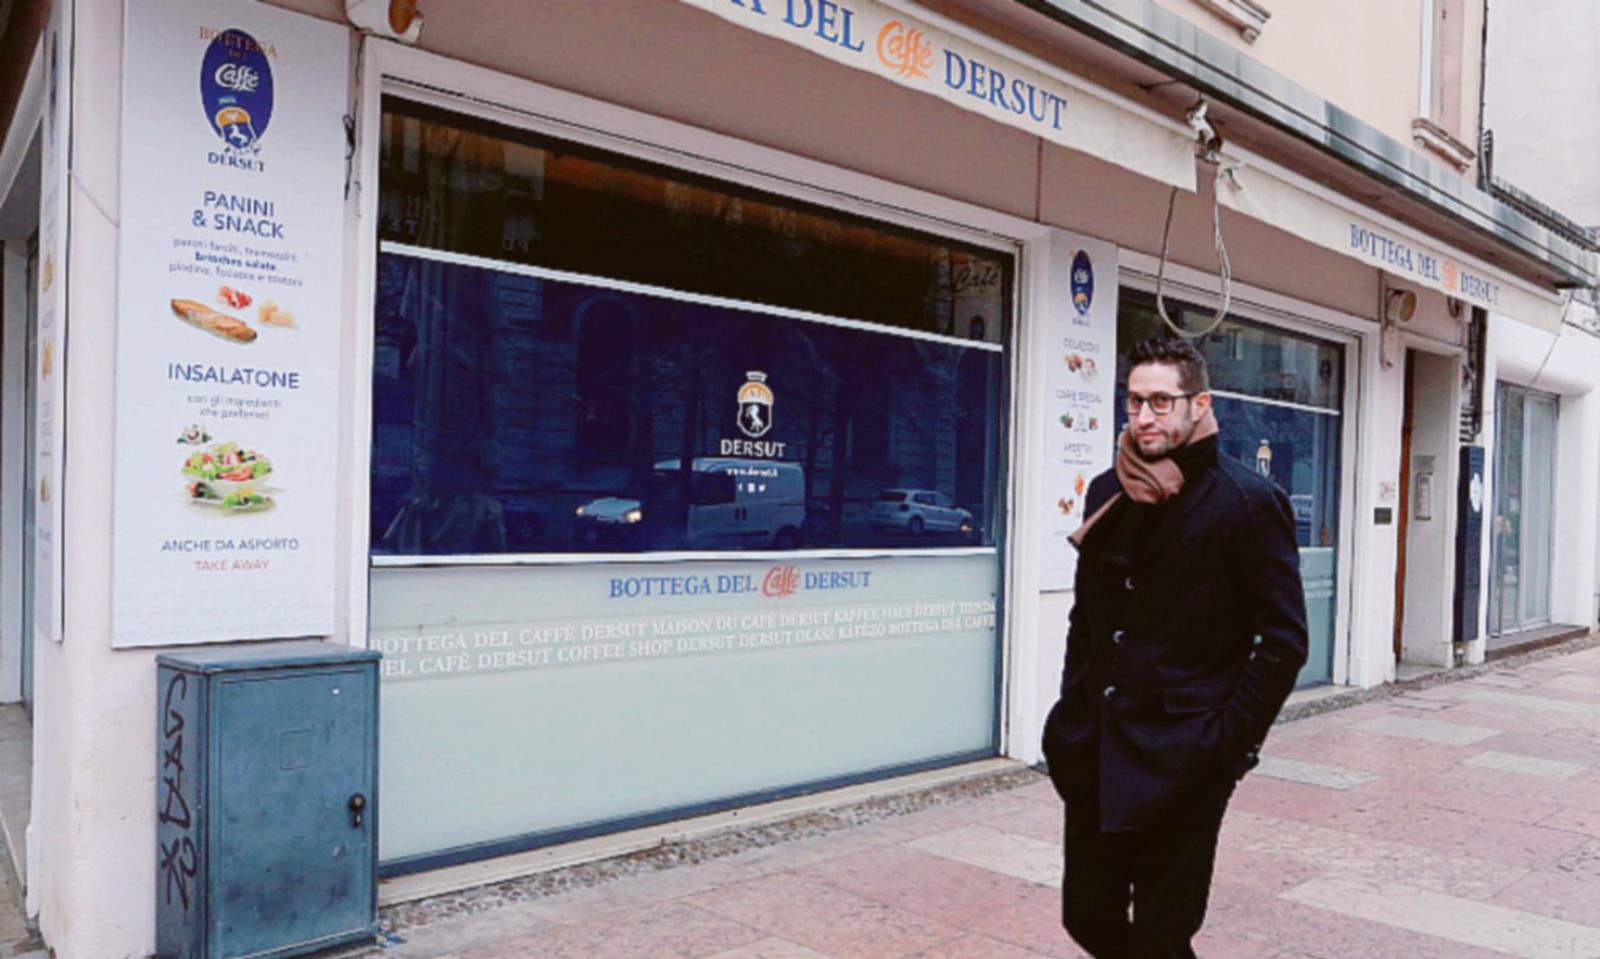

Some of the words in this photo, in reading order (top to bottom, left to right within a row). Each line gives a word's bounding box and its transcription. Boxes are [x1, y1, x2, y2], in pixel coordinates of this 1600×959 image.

[783, 0, 865, 52] DEL
[943, 49, 1068, 130] DERSUT
[208, 152, 265, 172] DERSUT
[203, 190, 275, 217] PANINI
[192, 209, 207, 228] &
[213, 213, 285, 239] SNACK
[1350, 224, 1414, 272] BOTTEGA
[1418, 253, 1440, 282] DEL
[167, 363, 300, 389] INSALATONE
[721, 439, 786, 457] DERSUT
[161, 539, 212, 552] ANCHE
[215, 540, 235, 551] DA
[238, 538, 300, 551] ASPORTO
[195, 560, 229, 572] TAKE
[232, 559, 270, 571] AWAY
[609, 575, 711, 598] BOTTEGA
[716, 574, 757, 594] DEL
[804, 570, 873, 591] DERSUT
[474, 630, 513, 648] DEL
[581, 622, 647, 641] DERSUT
[653, 617, 710, 635] MAISON
[715, 616, 737, 631] DU
[381, 659, 413, 676] EL
[477, 648, 553, 670] DERSUT
[558, 643, 624, 662] COFFEE
[629, 637, 672, 657] SHOP
[677, 634, 735, 653] DERSUT
